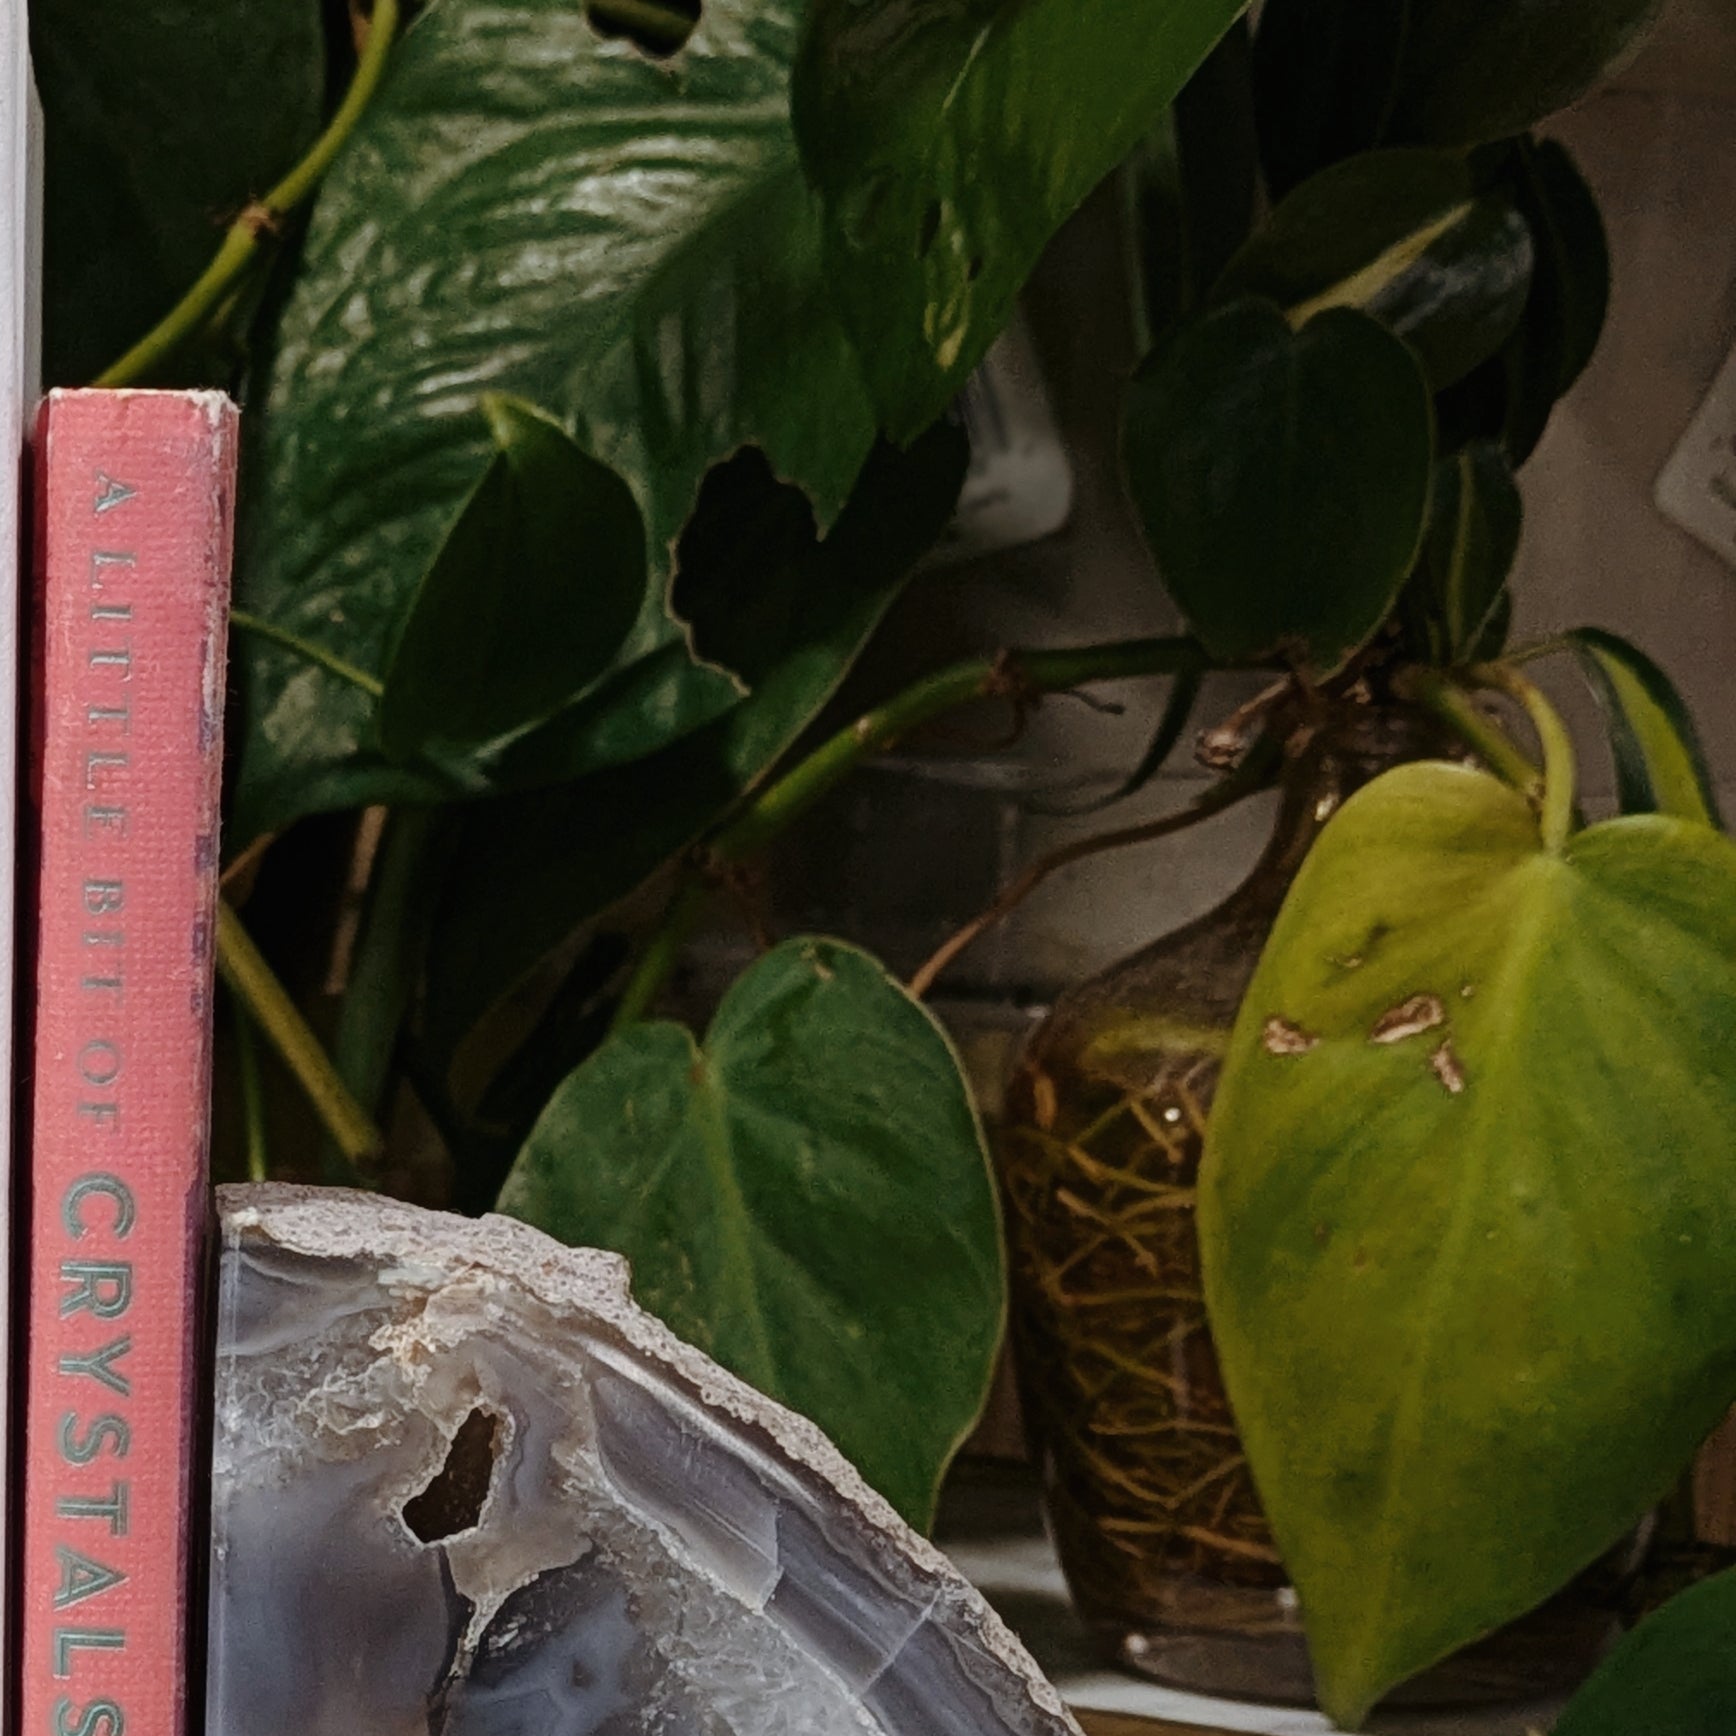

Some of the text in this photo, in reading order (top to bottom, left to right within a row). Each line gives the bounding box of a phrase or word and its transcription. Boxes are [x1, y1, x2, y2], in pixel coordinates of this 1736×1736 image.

[94, 470, 137, 513] A
[84, 551, 136, 840] LITTLE
[79, 879, 125, 1009] BIT
[75, 1039, 121, 1135] OF
